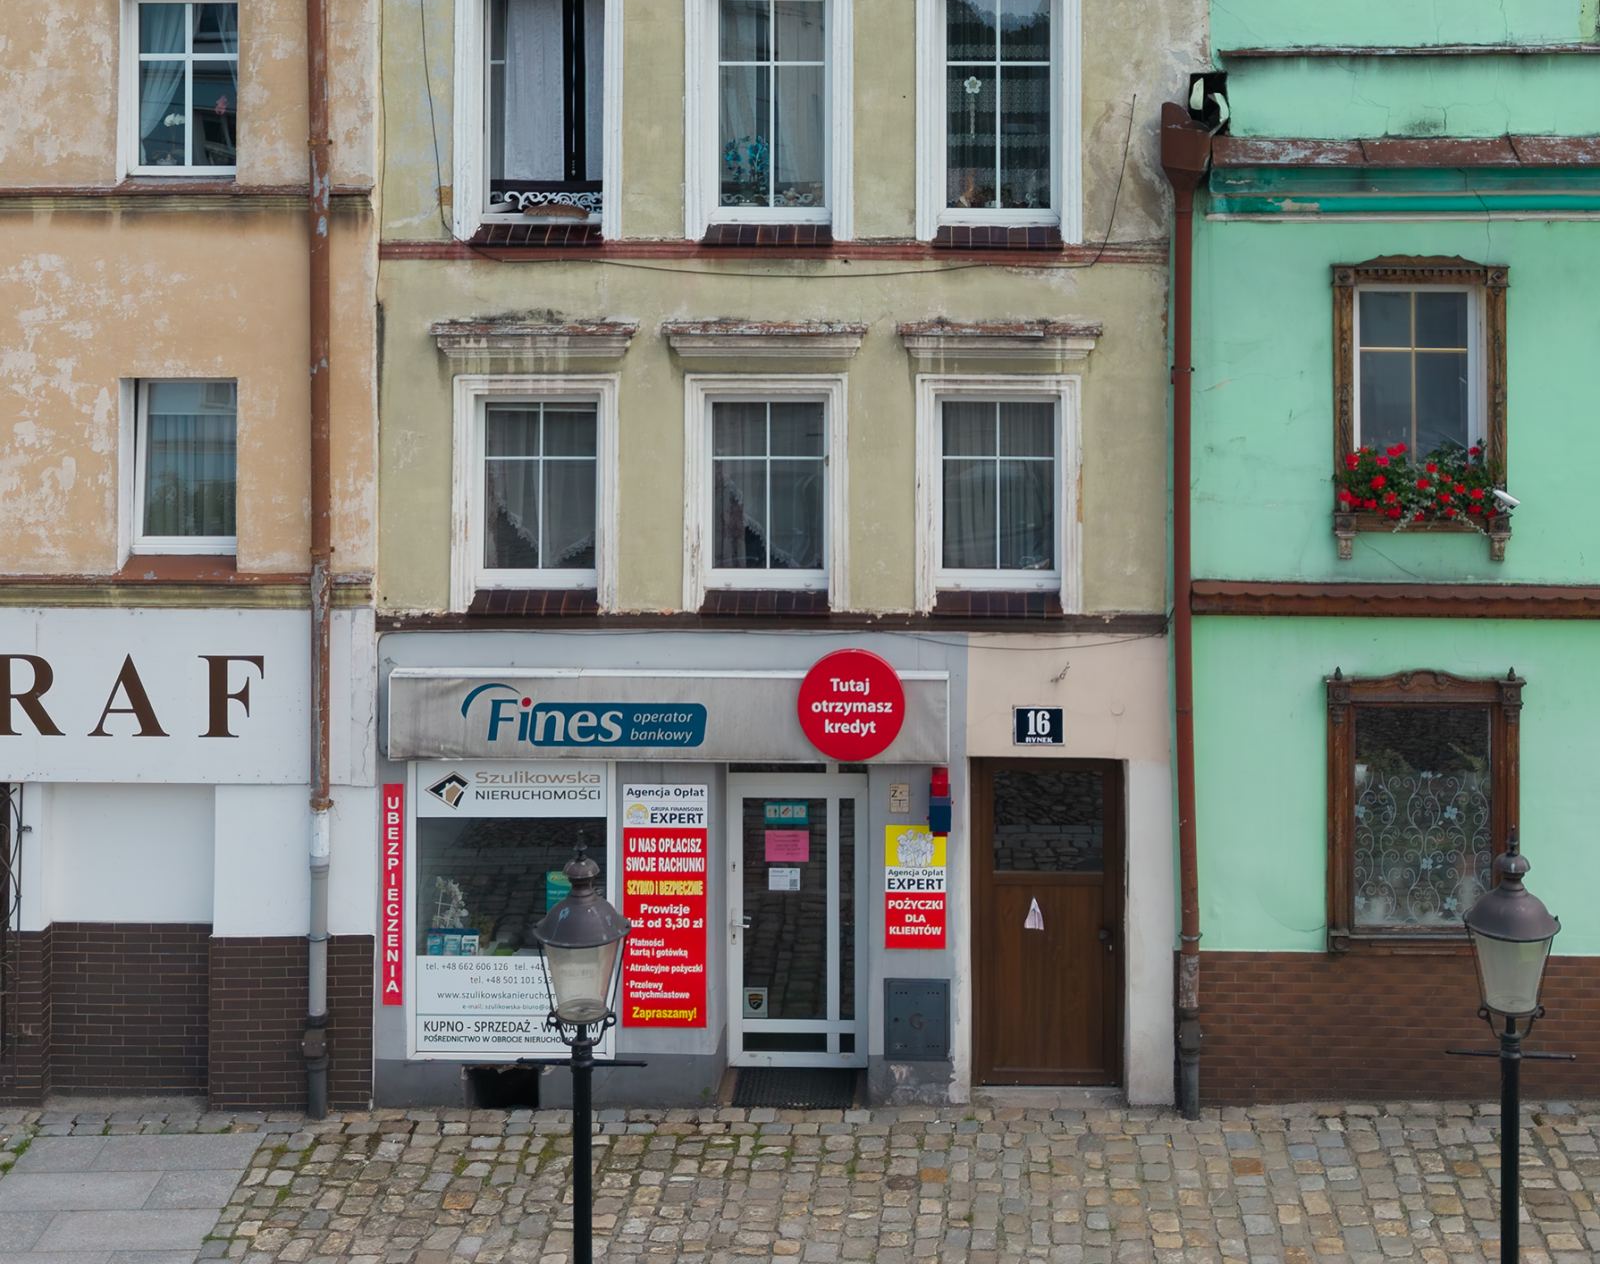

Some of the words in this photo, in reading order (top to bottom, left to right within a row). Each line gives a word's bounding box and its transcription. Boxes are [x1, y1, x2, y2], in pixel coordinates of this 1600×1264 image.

[830, 678, 870, 694] Tutaj
[0, 653, 264, 737] RAF
[811, 700, 893, 716] otrzymasz
[488, 697, 623, 743] Fines
[633, 711, 693, 726] operator
[1027, 710, 1051, 735] 16
[824, 719, 876, 736] kredyt
[630, 726, 693, 743] bankowy
[475, 771, 600, 784] Szulikowska
[475, 787, 601, 800] NIERUCHOMOŚCI
[626, 788, 670, 798] Agencja
[674, 788, 704, 798] Opłat
[650, 813, 703, 824] EXPERT
[629, 838, 636, 852] U
[638, 838, 656, 852] NAS
[659, 838, 702, 853] OPŁACISZ
[626, 857, 656, 872] SWOJE
[658, 857, 705, 872] RACHUNKI
[888, 869, 919, 877] Agencja
[921, 869, 944, 877] Opłat
[627, 880, 654, 895] SZYBKO
[659, 880, 703, 895] BEZPIECZNIE
[888, 878, 944, 890] EXPERT
[386, 796, 400, 992] UBEZPIECZENIA
[640, 904, 690, 916] Prowizje
[888, 898, 943, 910] POŻYCZKI
[647, 918, 661, 928] od
[665, 918, 690, 930] 3,30
[693, 918, 703, 928] zł
[905, 914, 926, 923] DLA
[889, 924, 941, 935] KLIENTÓW
[630, 938, 664, 947] Płatności
[630, 948, 650, 958] kartą
[656, 948, 688, 958] gotówką
[441, 962, 456, 970] +48
[458, 962, 474, 971] 662
[475, 962, 491, 971] 606
[493, 962, 509, 971] 126
[514, 962, 528, 971] tel.
[630, 963, 669, 974] Atrakcyjne
[671, 964, 703, 974] pożyczki
[470, 976, 483, 984] tel.
[486, 976, 501, 984] +48
[503, 976, 518, 984] 501
[521, 976, 535, 984] 101
[630, 980, 663, 990] Przelewy
[630, 990, 690, 1000] natychmiastowe
[632, 1006, 697, 1021] Zapraszamy!
[424, 1020, 464, 1033] KUPNO
[474, 1019, 531, 1033] SPRZEDAŻ
[424, 1034, 480, 1042] POŚREDNICTWO
